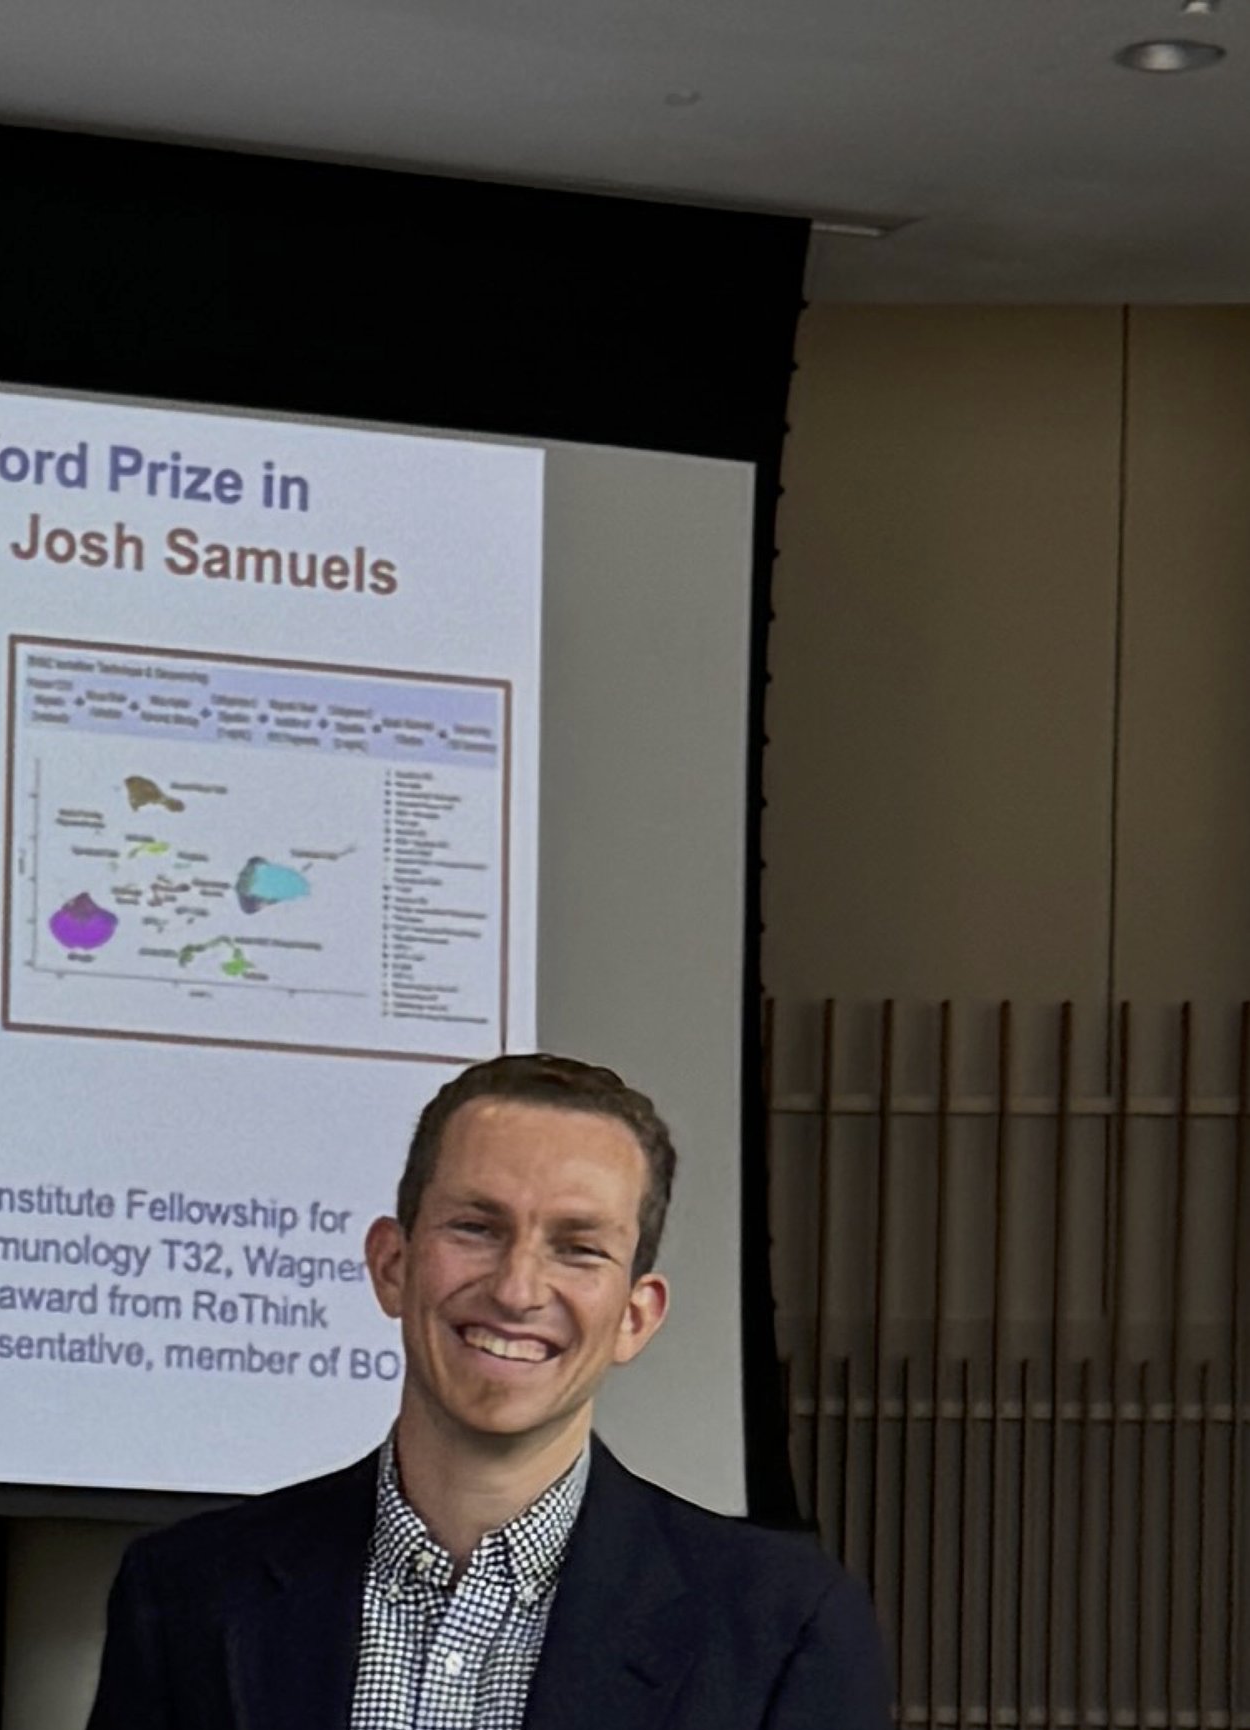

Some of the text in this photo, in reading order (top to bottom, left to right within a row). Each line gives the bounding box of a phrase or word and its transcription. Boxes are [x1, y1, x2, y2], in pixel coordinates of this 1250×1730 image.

[107, 444, 245, 506] Prize
[261, 459, 310, 513] in
[9, 512, 145, 573] Josh
[163, 526, 398, 596] Samuels
[125, 1187, 300, 1239] Fellowship
[308, 1200, 353, 1235] for
[159, 1237, 234, 1280] T32,
[106, 1283, 183, 1320] from
[192, 1288, 329, 1330] ReThink
[164, 1341, 302, 1376] member
[308, 1345, 342, 1378] of
